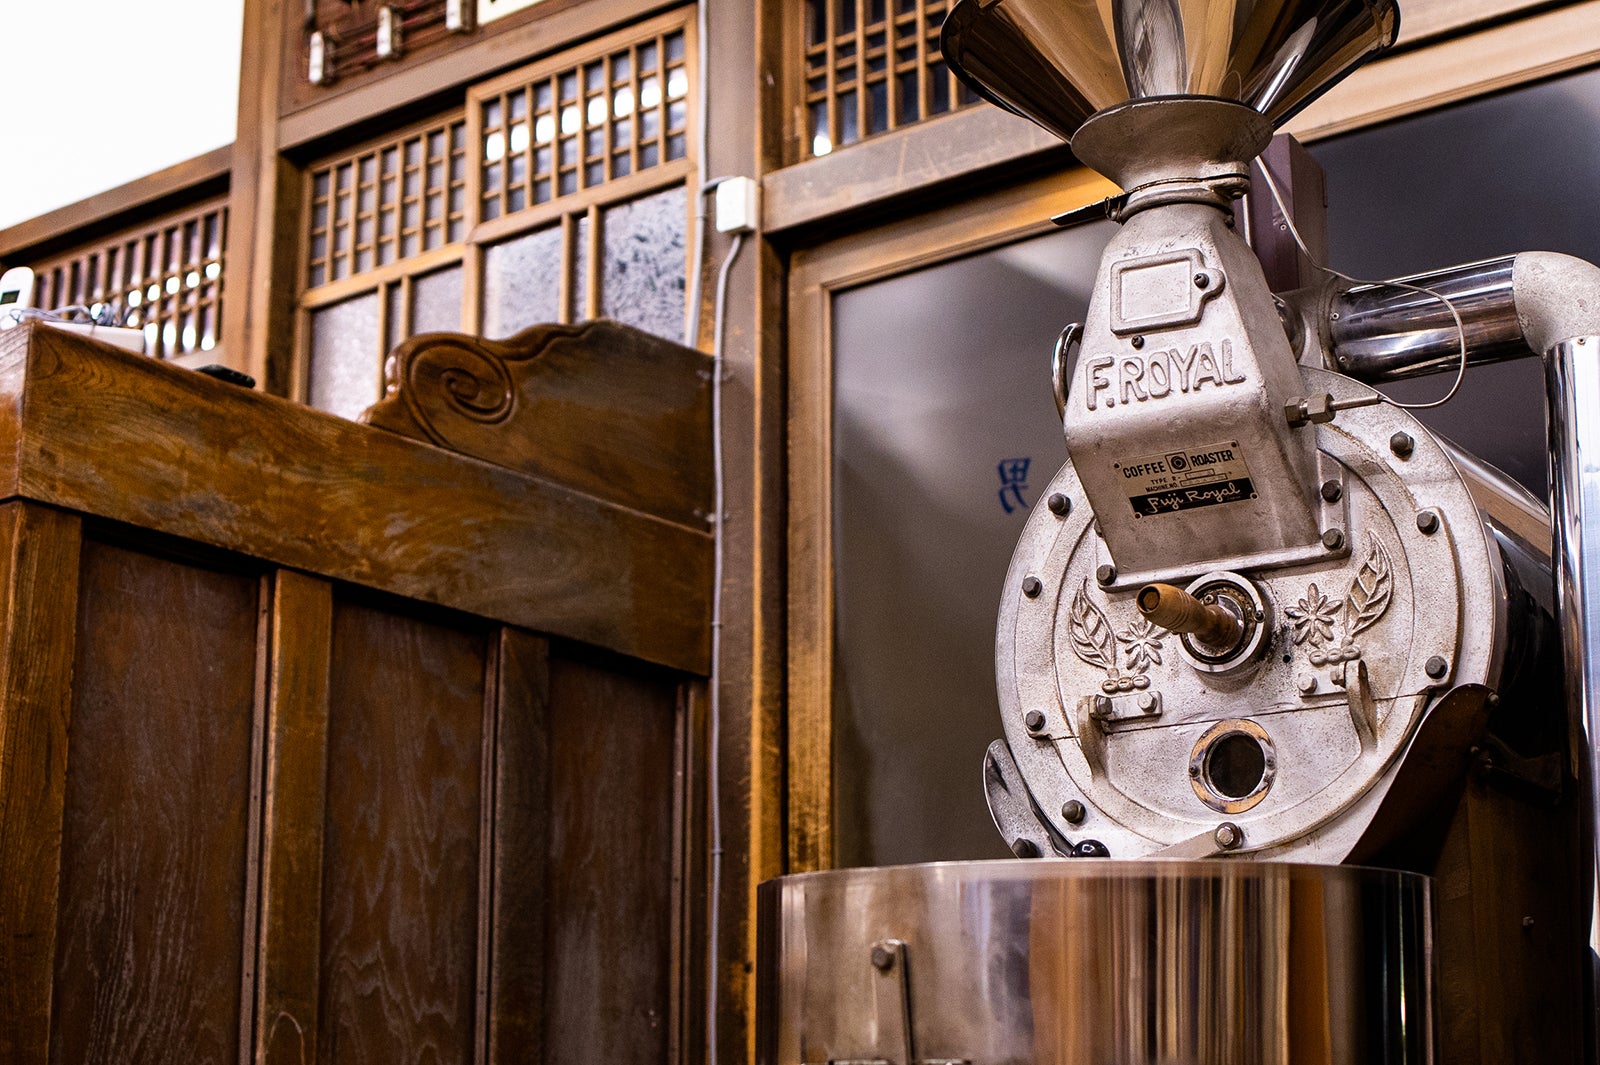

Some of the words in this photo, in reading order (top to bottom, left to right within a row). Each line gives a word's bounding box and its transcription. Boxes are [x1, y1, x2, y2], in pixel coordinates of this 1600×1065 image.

[1086, 338, 1246, 411] F.ROYAL
[1123, 461, 1166, 478] COFFEE
[1190, 450, 1235, 466] ROASTER
[1146, 493, 1184, 513] Fuji
[1185, 482, 1240, 502] Royal
